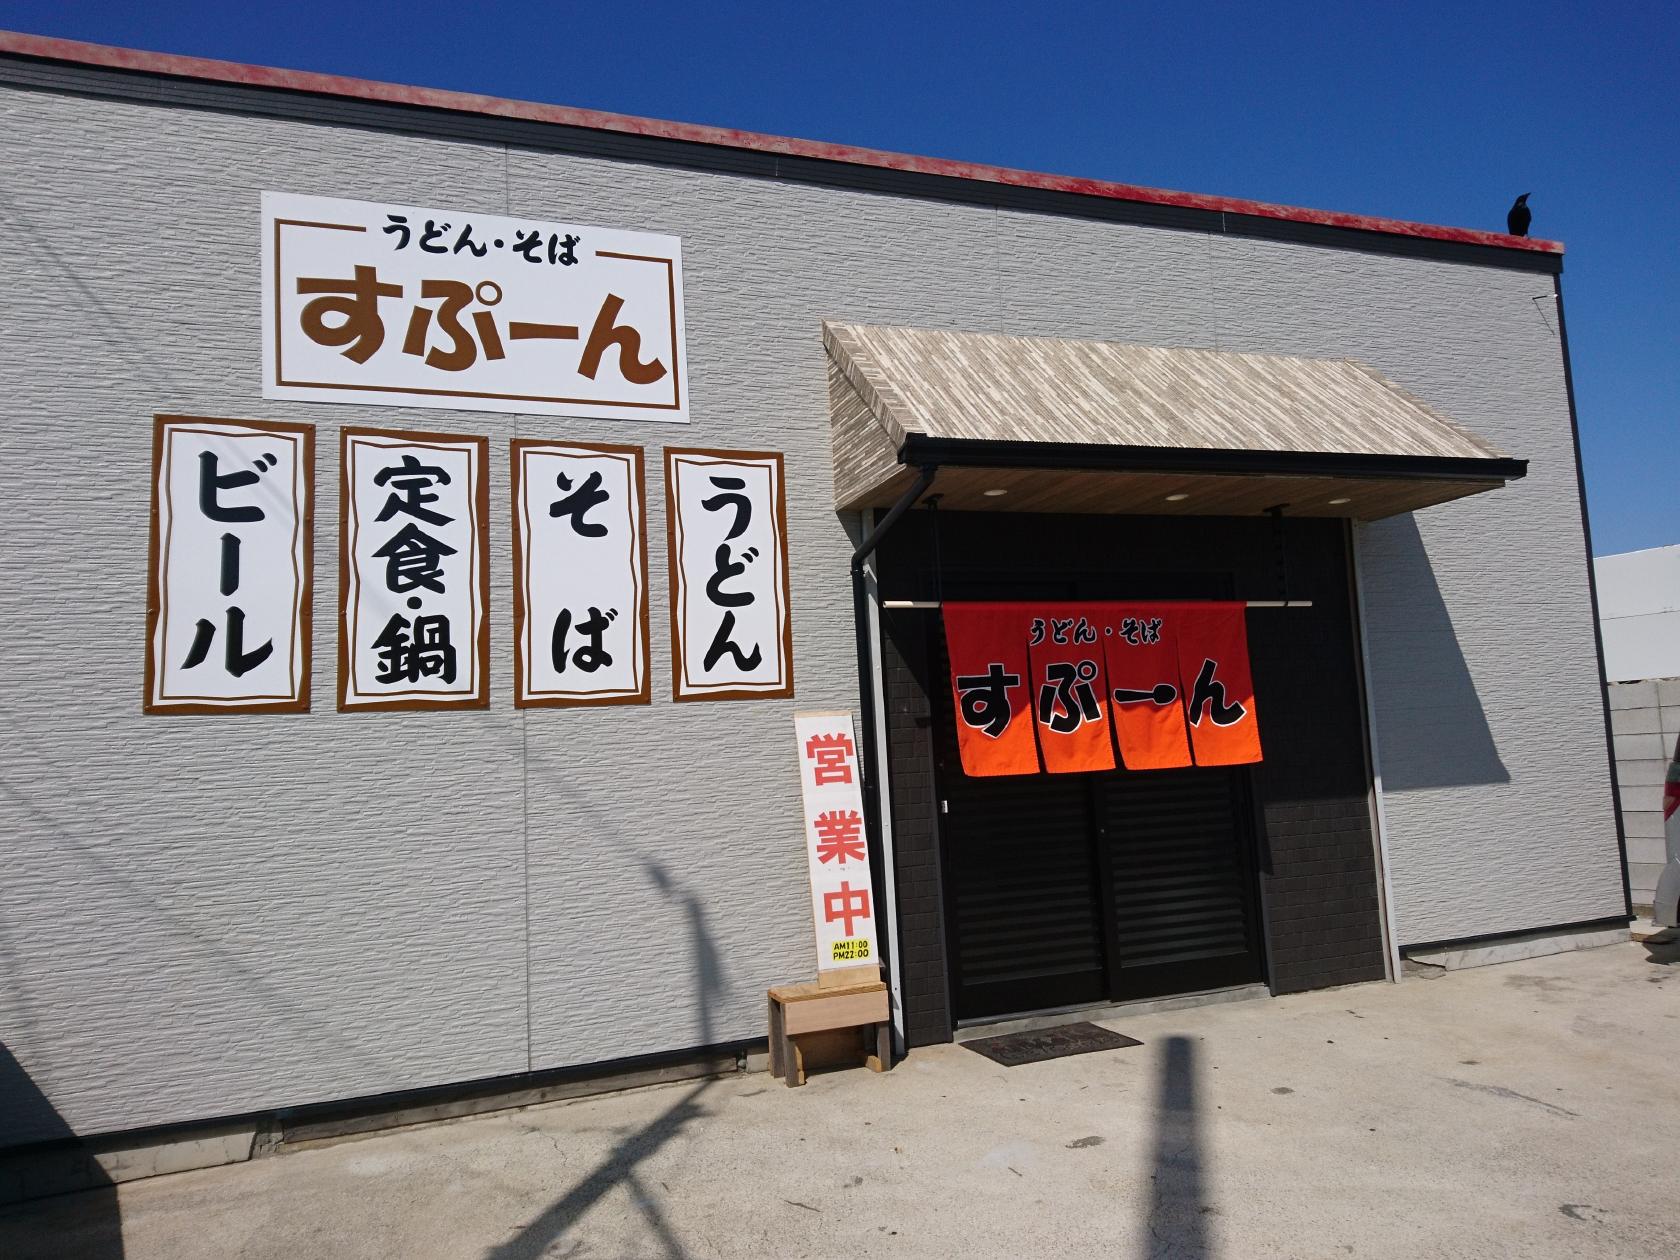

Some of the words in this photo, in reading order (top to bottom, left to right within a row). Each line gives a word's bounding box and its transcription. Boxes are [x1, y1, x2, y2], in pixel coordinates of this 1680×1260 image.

[382, 214, 581, 267] うどん・そば
[295, 264, 668, 385] すぷーん
[180, 450, 278, 678] ビール
[370, 454, 459, 685] 定食・鍋
[548, 470, 619, 674] そば
[701, 476, 763, 673] うどん
[1030, 617, 1162, 646] うどん・そば
[956, 657, 1248, 739] すぷーん
[806, 733, 871, 937] 営業中
[833, 940, 868, 951] AM11:00
[833, 949, 869, 960] PM22:00
